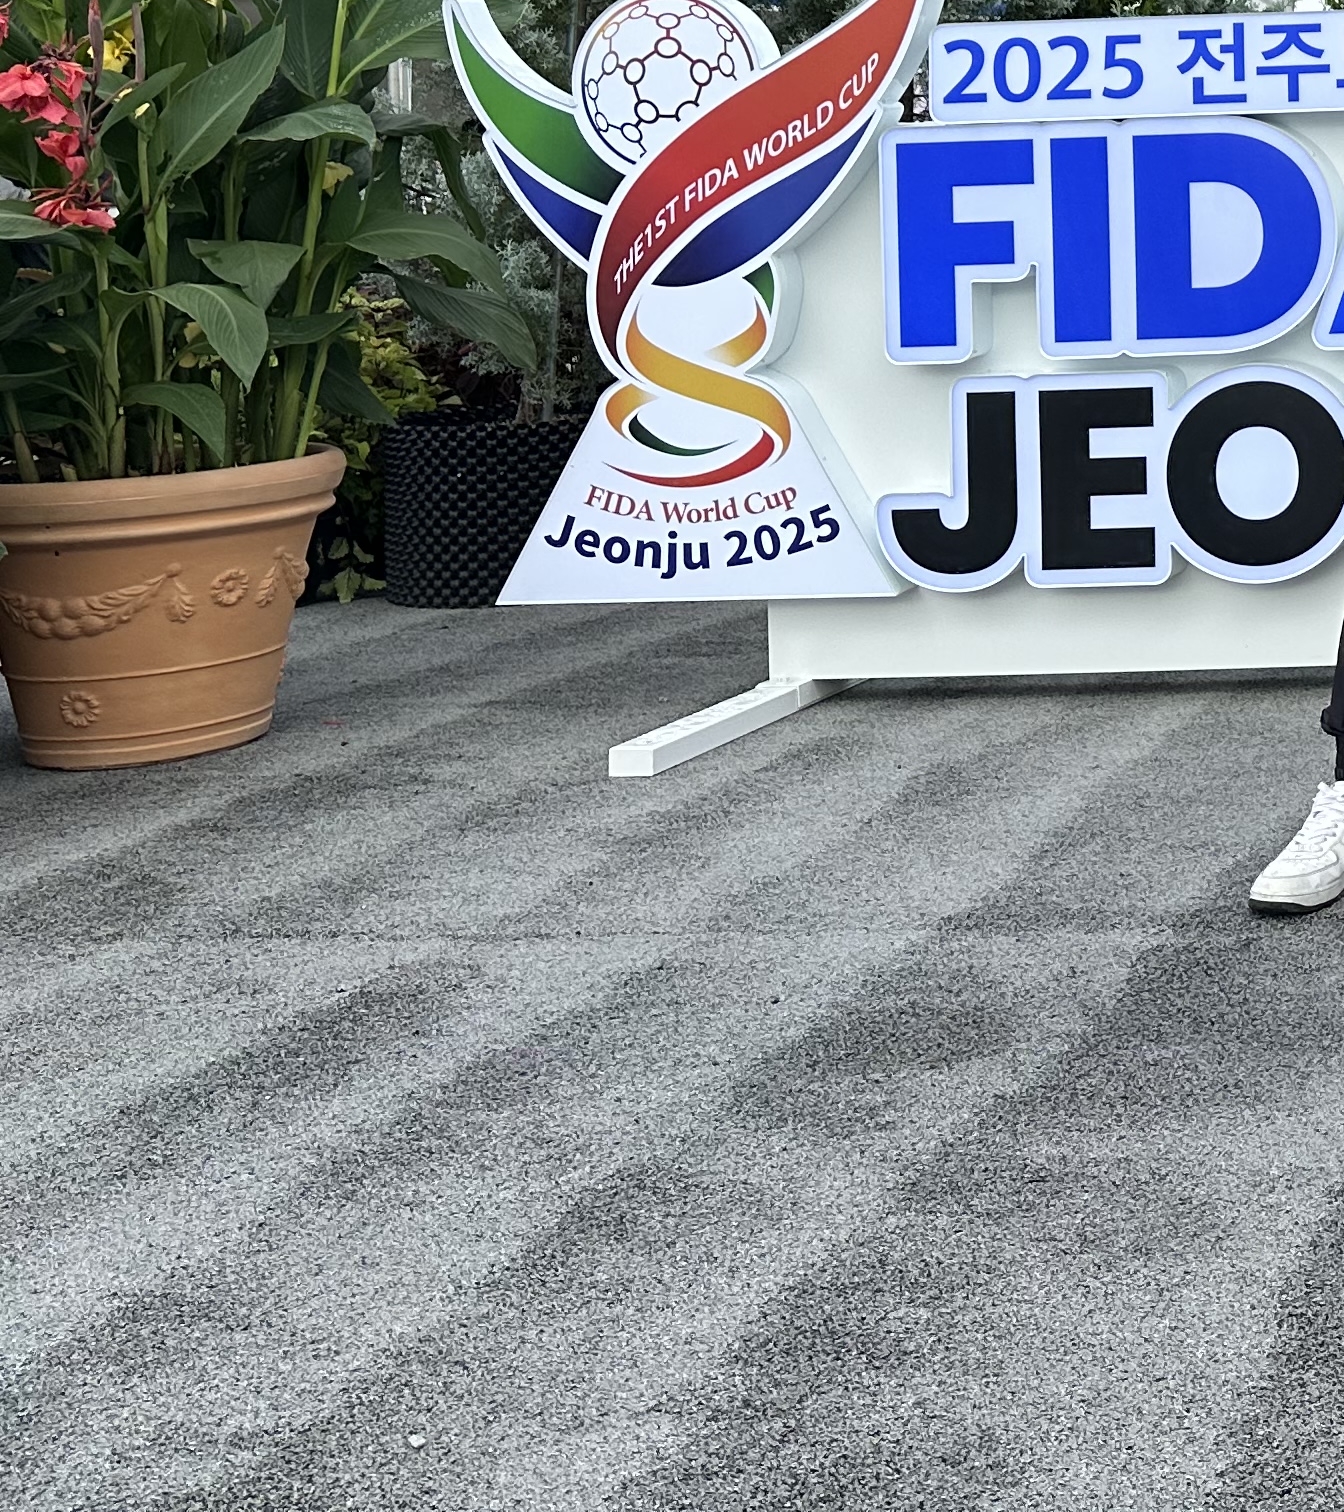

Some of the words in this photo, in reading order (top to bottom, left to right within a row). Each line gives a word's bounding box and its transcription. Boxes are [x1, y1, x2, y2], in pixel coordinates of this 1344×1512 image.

[942, 34, 1145, 105] 2025
[683, 157, 739, 213] FIDA
[742, 100, 834, 172] WORLD
[838, 52, 880, 111] CUP
[584, 484, 655, 521] FIDA
[660, 497, 740, 524] World
[744, 486, 797, 514] Cup
[544, 514, 711, 579] Jeonju
[723, 503, 841, 567] 2025
